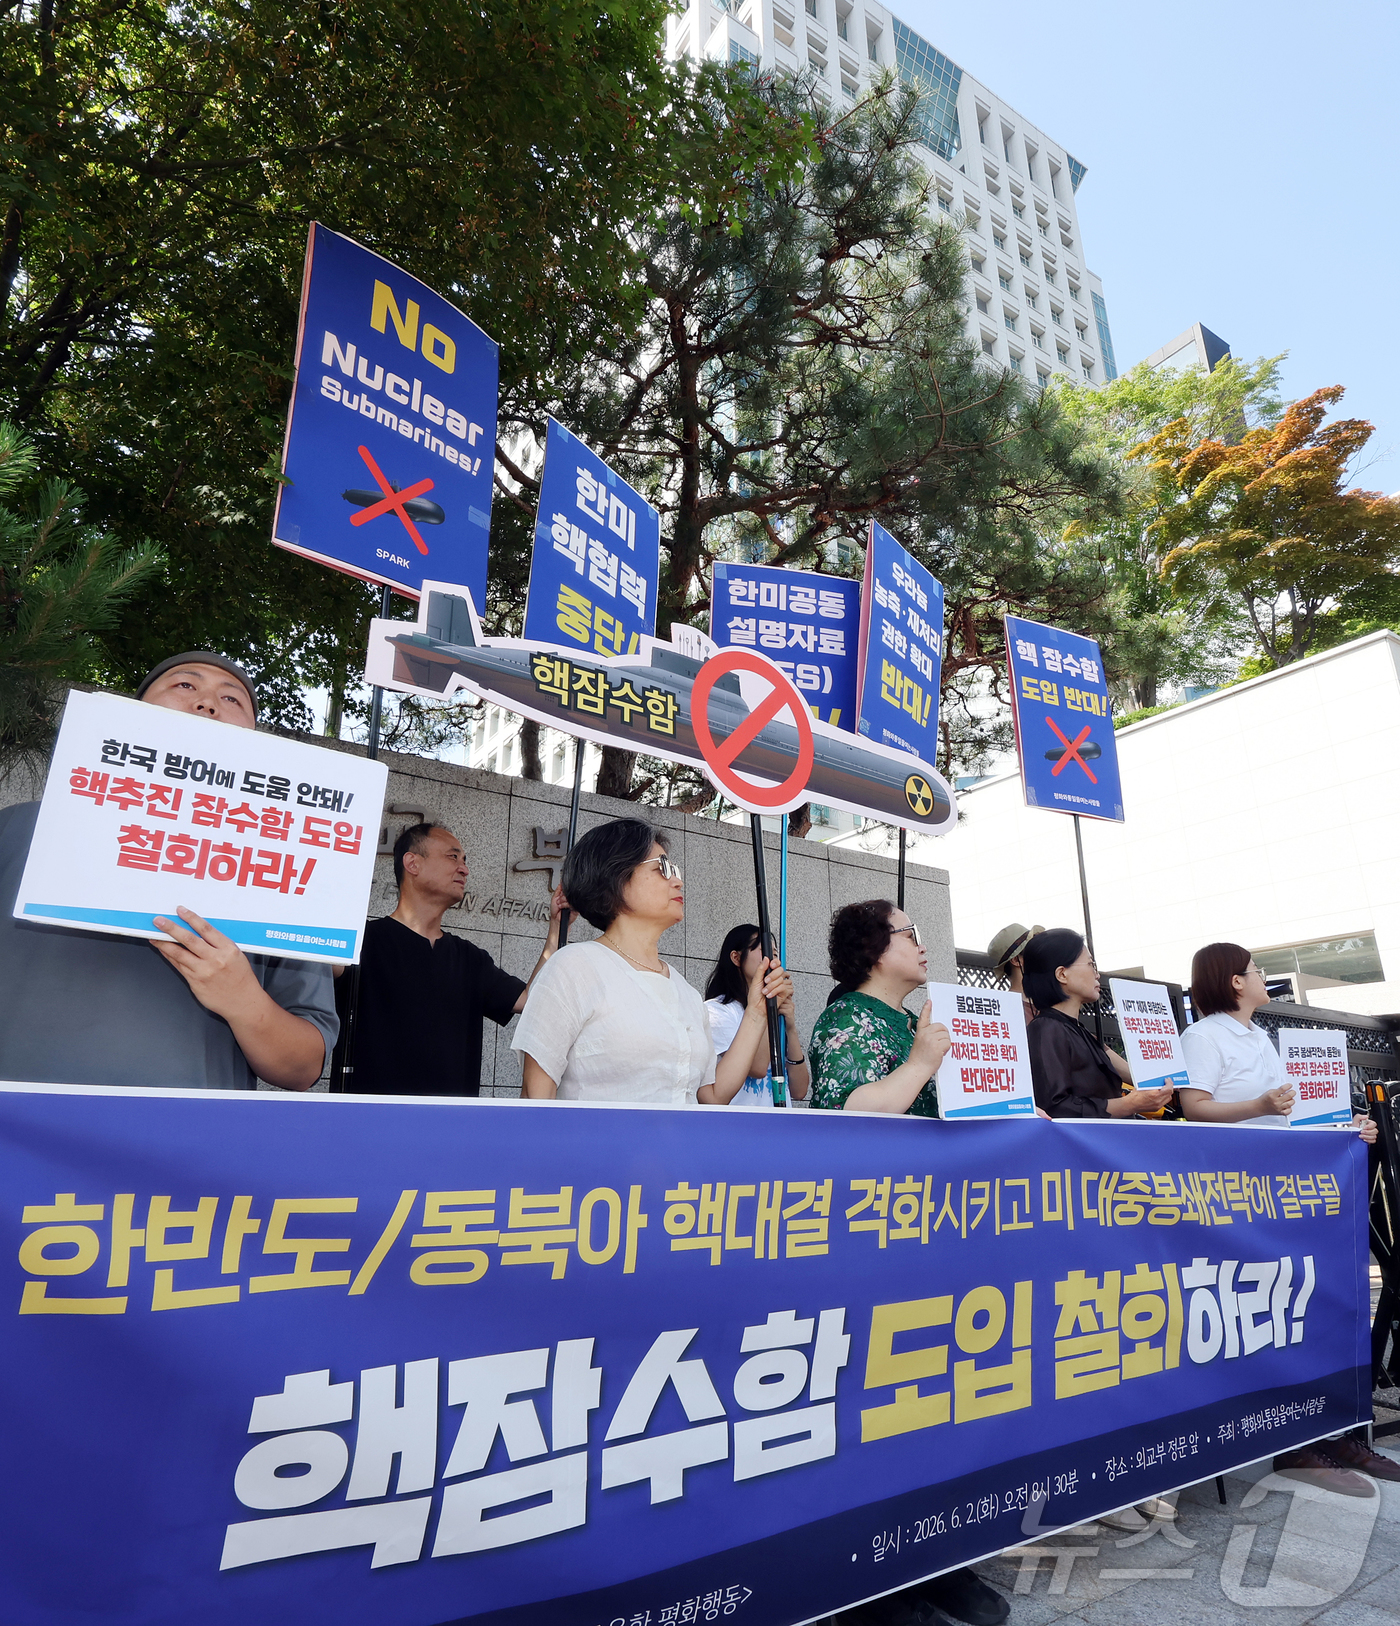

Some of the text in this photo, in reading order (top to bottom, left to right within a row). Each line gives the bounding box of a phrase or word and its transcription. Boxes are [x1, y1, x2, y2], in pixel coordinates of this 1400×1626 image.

[370, 279, 456, 374] No
[321, 330, 484, 447] Nuclear
[320, 375, 481, 476] Submarines!
[575, 465, 636, 552] 한미
[376, 548, 410, 569] SPARK
[551, 513, 648, 618] 핵협력
[728, 578, 846, 619] 한미공동
[892, 562, 928, 612] 우라늄
[727, 617, 846, 657] 설명자료
[882, 618, 933, 682] 권한 확대
[1015, 639, 1100, 684] 핵 잠수함
[531, 655, 679, 736] 핵잠수함
[881, 658, 932, 728] 반대!
[1021, 675, 1107, 717] 도입 반대!
[100, 739, 354, 814] 한국 방어에 도움 안돼!
[68, 767, 364, 856] 핵추진 잠수함 도입
[116, 824, 319, 896] 철회하라!
[483, 897, 551, 922] AFFAIR
[265, 929, 348, 949] 평화와통일을여는사람들
[952, 1018, 1010, 1040] 우라늄 농축 및
[956, 995, 1001, 1016] 불요불급한
[1123, 1016, 1176, 1035] 핵추진 잠수함 도입
[951, 1042, 1018, 1062] 재처리 권한 확대
[1138, 1039, 1174, 1060] 철회하라!
[1286, 1061, 1346, 1077] 핵추진 잠수함 도입
[960, 1067, 1015, 1093] 반대한다!
[1299, 1080, 1338, 1100] 철회하라!
[18, 1170, 1342, 1315] 한반도/동북아 핵대결 격화시키고 미 대중봉쇄전략에 결부될
[219, 1255, 1317, 1572] 핵잠수함 도입 철회하라!
[1217, 1420, 1236, 1445] 주최
[1240, 1395, 1326, 1438] 평화와통일을여는사람들
[1104, 1456, 1129, 1482] 장소
[1136, 1441, 1167, 1470] 외교부
[1167, 1437, 1188, 1462] 정문
[1188, 1431, 1200, 1454] 앞
[872, 1525, 901, 1563] 일시
[913, 1511, 947, 1543] 2026.
[951, 1506, 962, 1529] 6.
[1002, 1482, 1029, 1513] 오전
[1031, 1478, 1051, 1503] 8시
[1054, 1469, 1079, 1496] 30분
